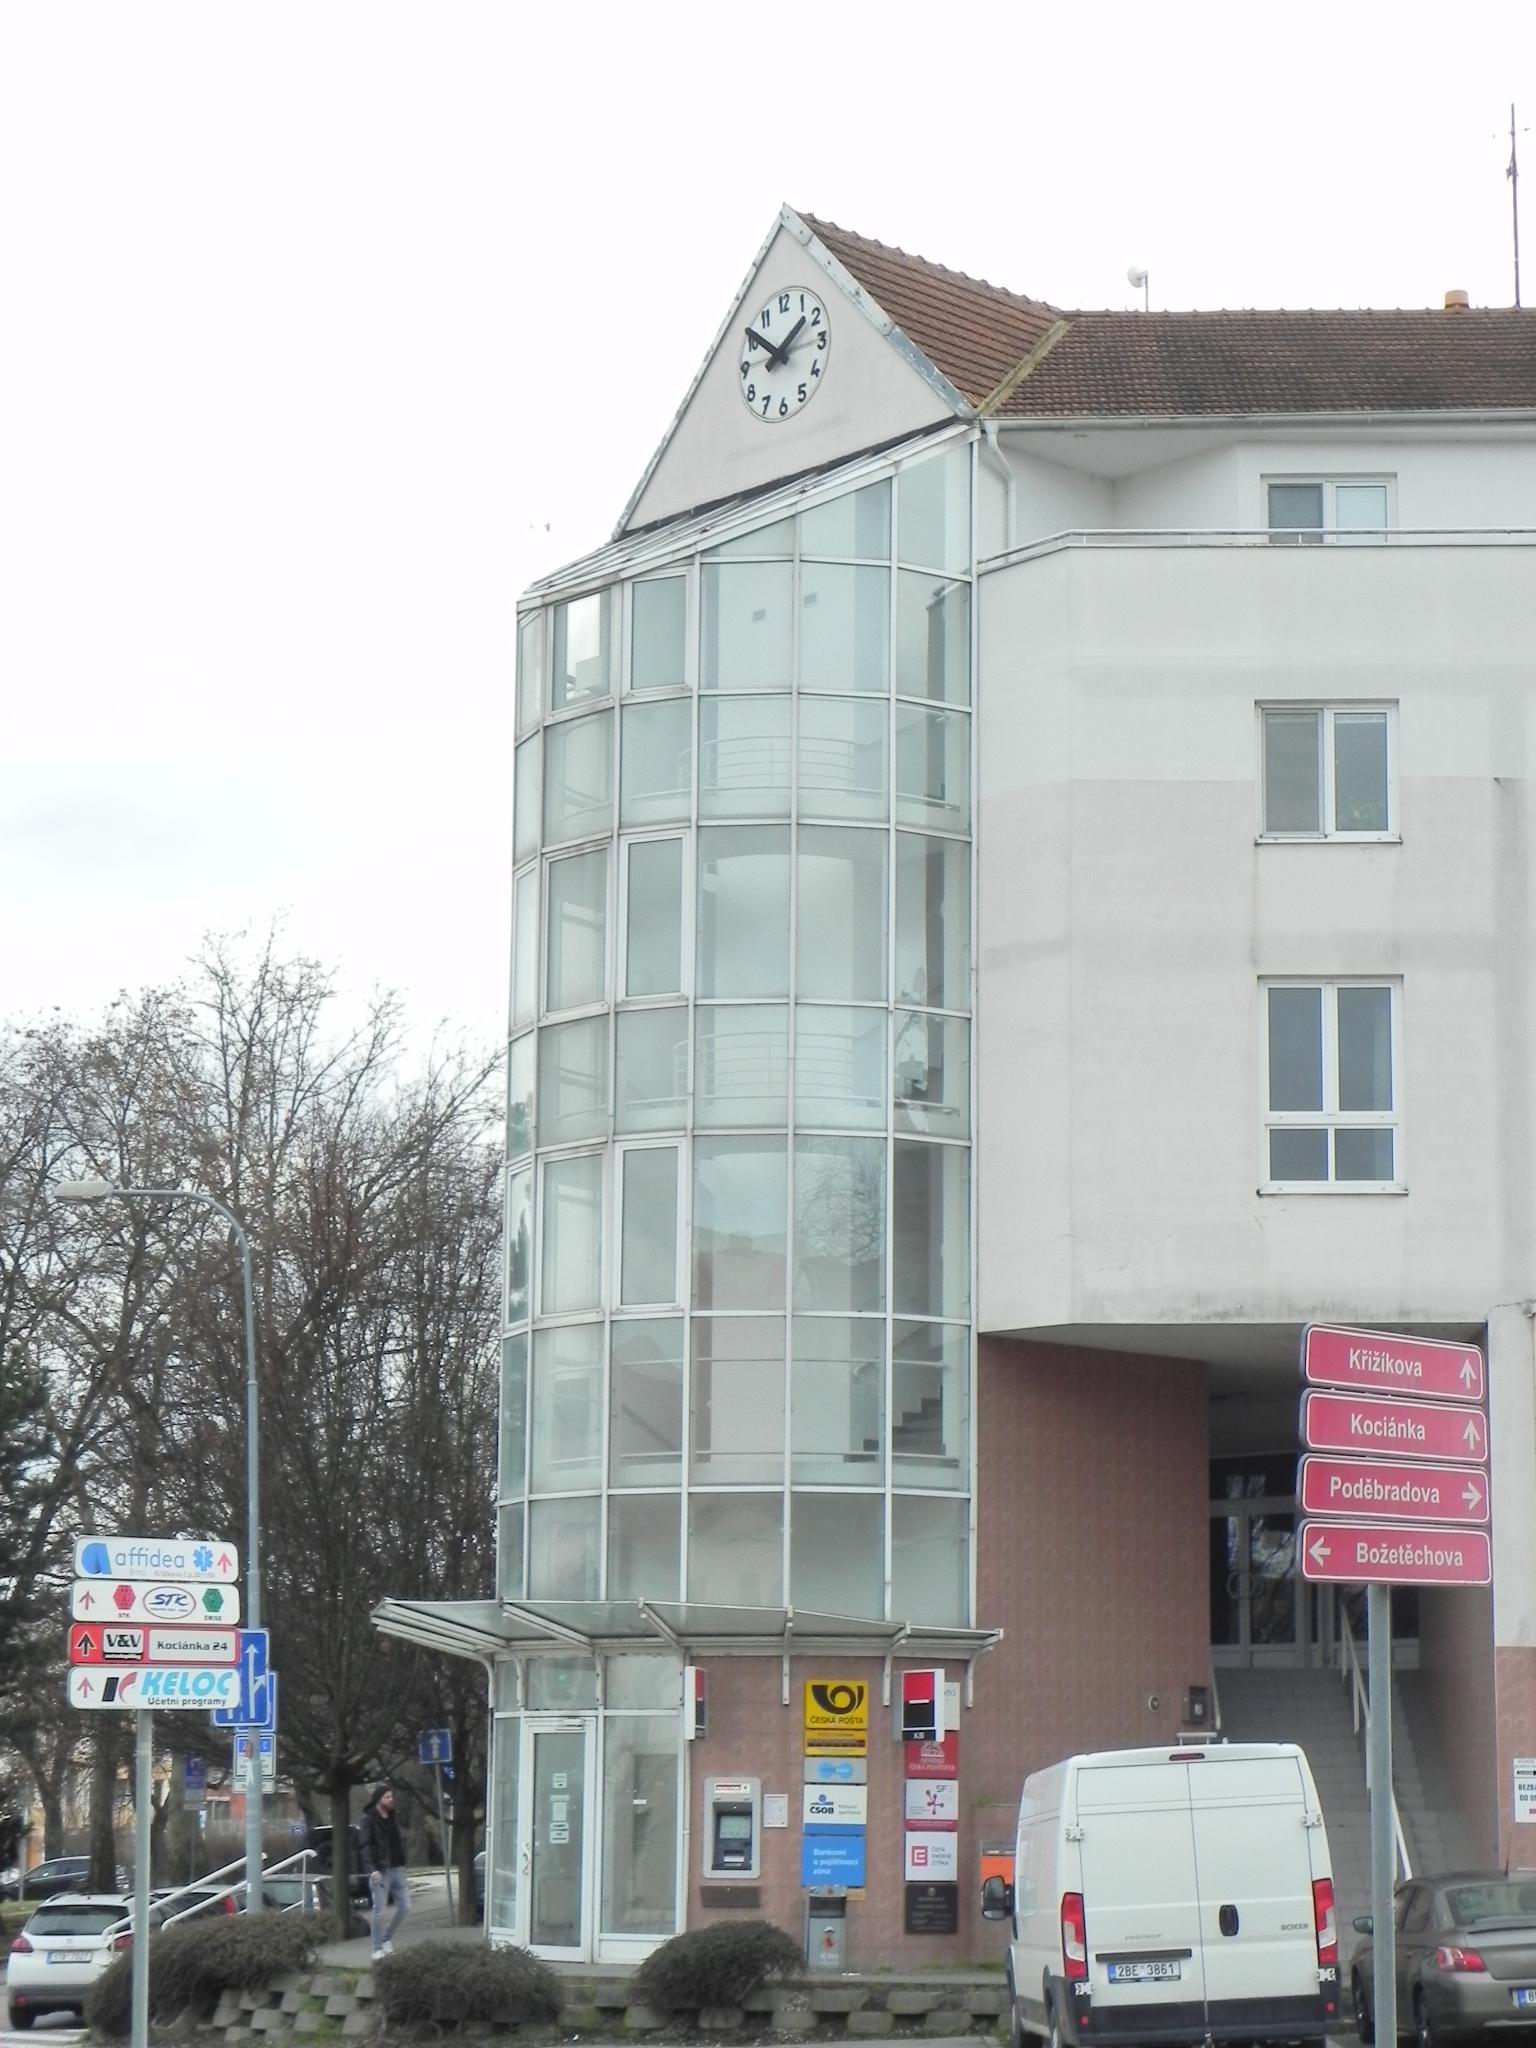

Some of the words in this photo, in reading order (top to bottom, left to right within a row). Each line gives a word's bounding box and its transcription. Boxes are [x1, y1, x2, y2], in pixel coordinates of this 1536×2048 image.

[778, 293, 790, 314] 12
[800, 293, 805, 313] 1
[761, 309, 770, 329] 11
[811, 306, 821, 327] 2
[817, 330, 827, 350] 3
[740, 360, 751, 380] 9
[810, 359, 821, 378] 4
[747, 383, 756, 402] 8
[797, 383, 807, 402] 5
[761, 394, 771, 416] 7
[778, 396, 788, 416] 6
[1349, 1347, 1423, 1377] Křižíkova
[1351, 1413, 1426, 1441] Kociánka
[1329, 1475, 1440, 1504] Poděbradova
[114, 1546, 185, 1569] affidea
[1356, 1541, 1464, 1567] Božetěchova
[151, 1593, 188, 1607] STK
[106, 1633, 142, 1648] V&V
[157, 1640, 210, 1651] Kociánka
[212, 1642, 228, 1651] 24
[141, 1671, 234, 1697] KELOC
[182, 1697, 227, 1707] programy
[1147, 1963, 1175, 1976] 3861
